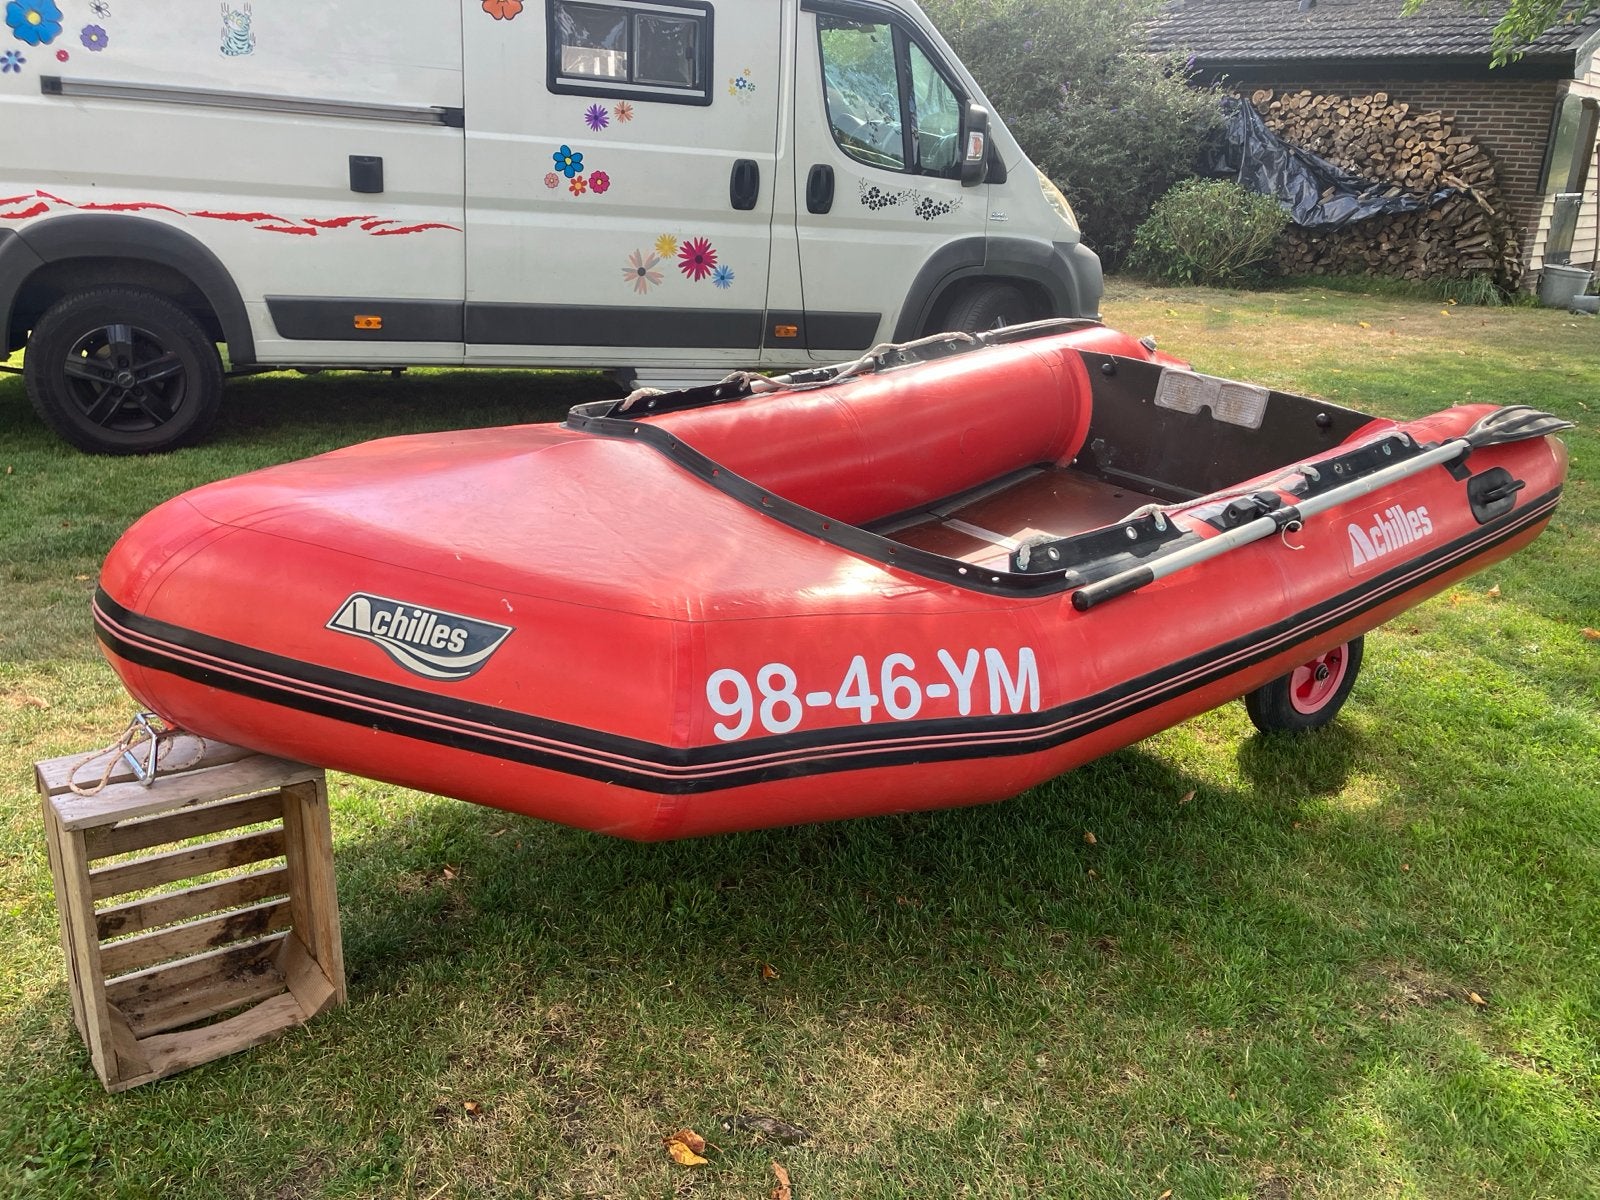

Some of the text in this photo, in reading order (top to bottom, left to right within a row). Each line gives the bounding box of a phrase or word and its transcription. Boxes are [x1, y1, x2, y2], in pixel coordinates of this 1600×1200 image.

[1347, 504, 1434, 568] Achilles
[335, 597, 468, 653] Achilles
[705, 646, 1041, 742] 98-46-YM
